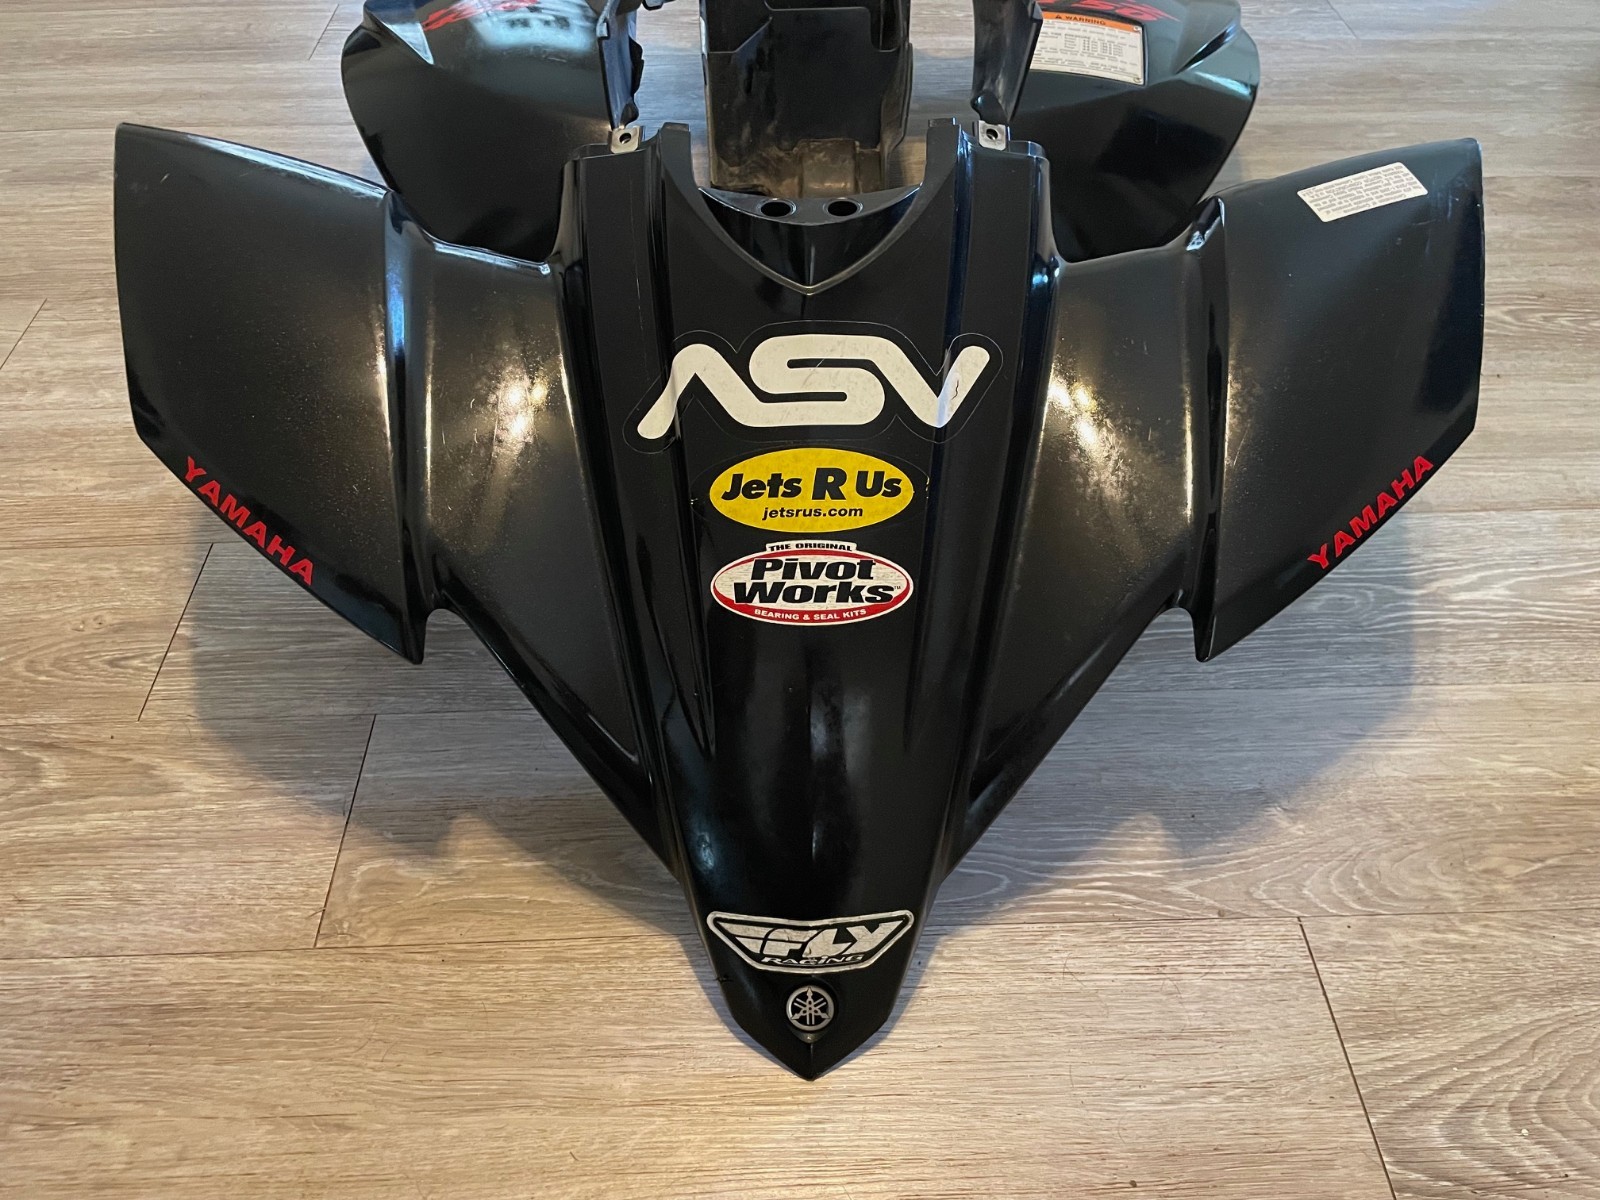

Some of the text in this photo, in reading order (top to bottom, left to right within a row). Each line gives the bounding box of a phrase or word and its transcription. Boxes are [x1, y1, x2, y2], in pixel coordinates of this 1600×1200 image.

[1065, 15, 1106, 25] WARNING
[637, 334, 990, 439] ASV
[721, 467, 902, 501] Jets R Us
[185, 456, 314, 586] YAMAHA
[762, 507, 863, 521] jetsrus.com
[1307, 456, 1434, 569] YAMAHA
[768, 542, 852, 551] THE ORIGINAL
[751, 558, 876, 580] Pivot
[733, 581, 895, 604] Works
[754, 608, 867, 621] BEARING & SEAL KITS
[717, 919, 904, 957] FLY
[761, 953, 865, 965] RACING
